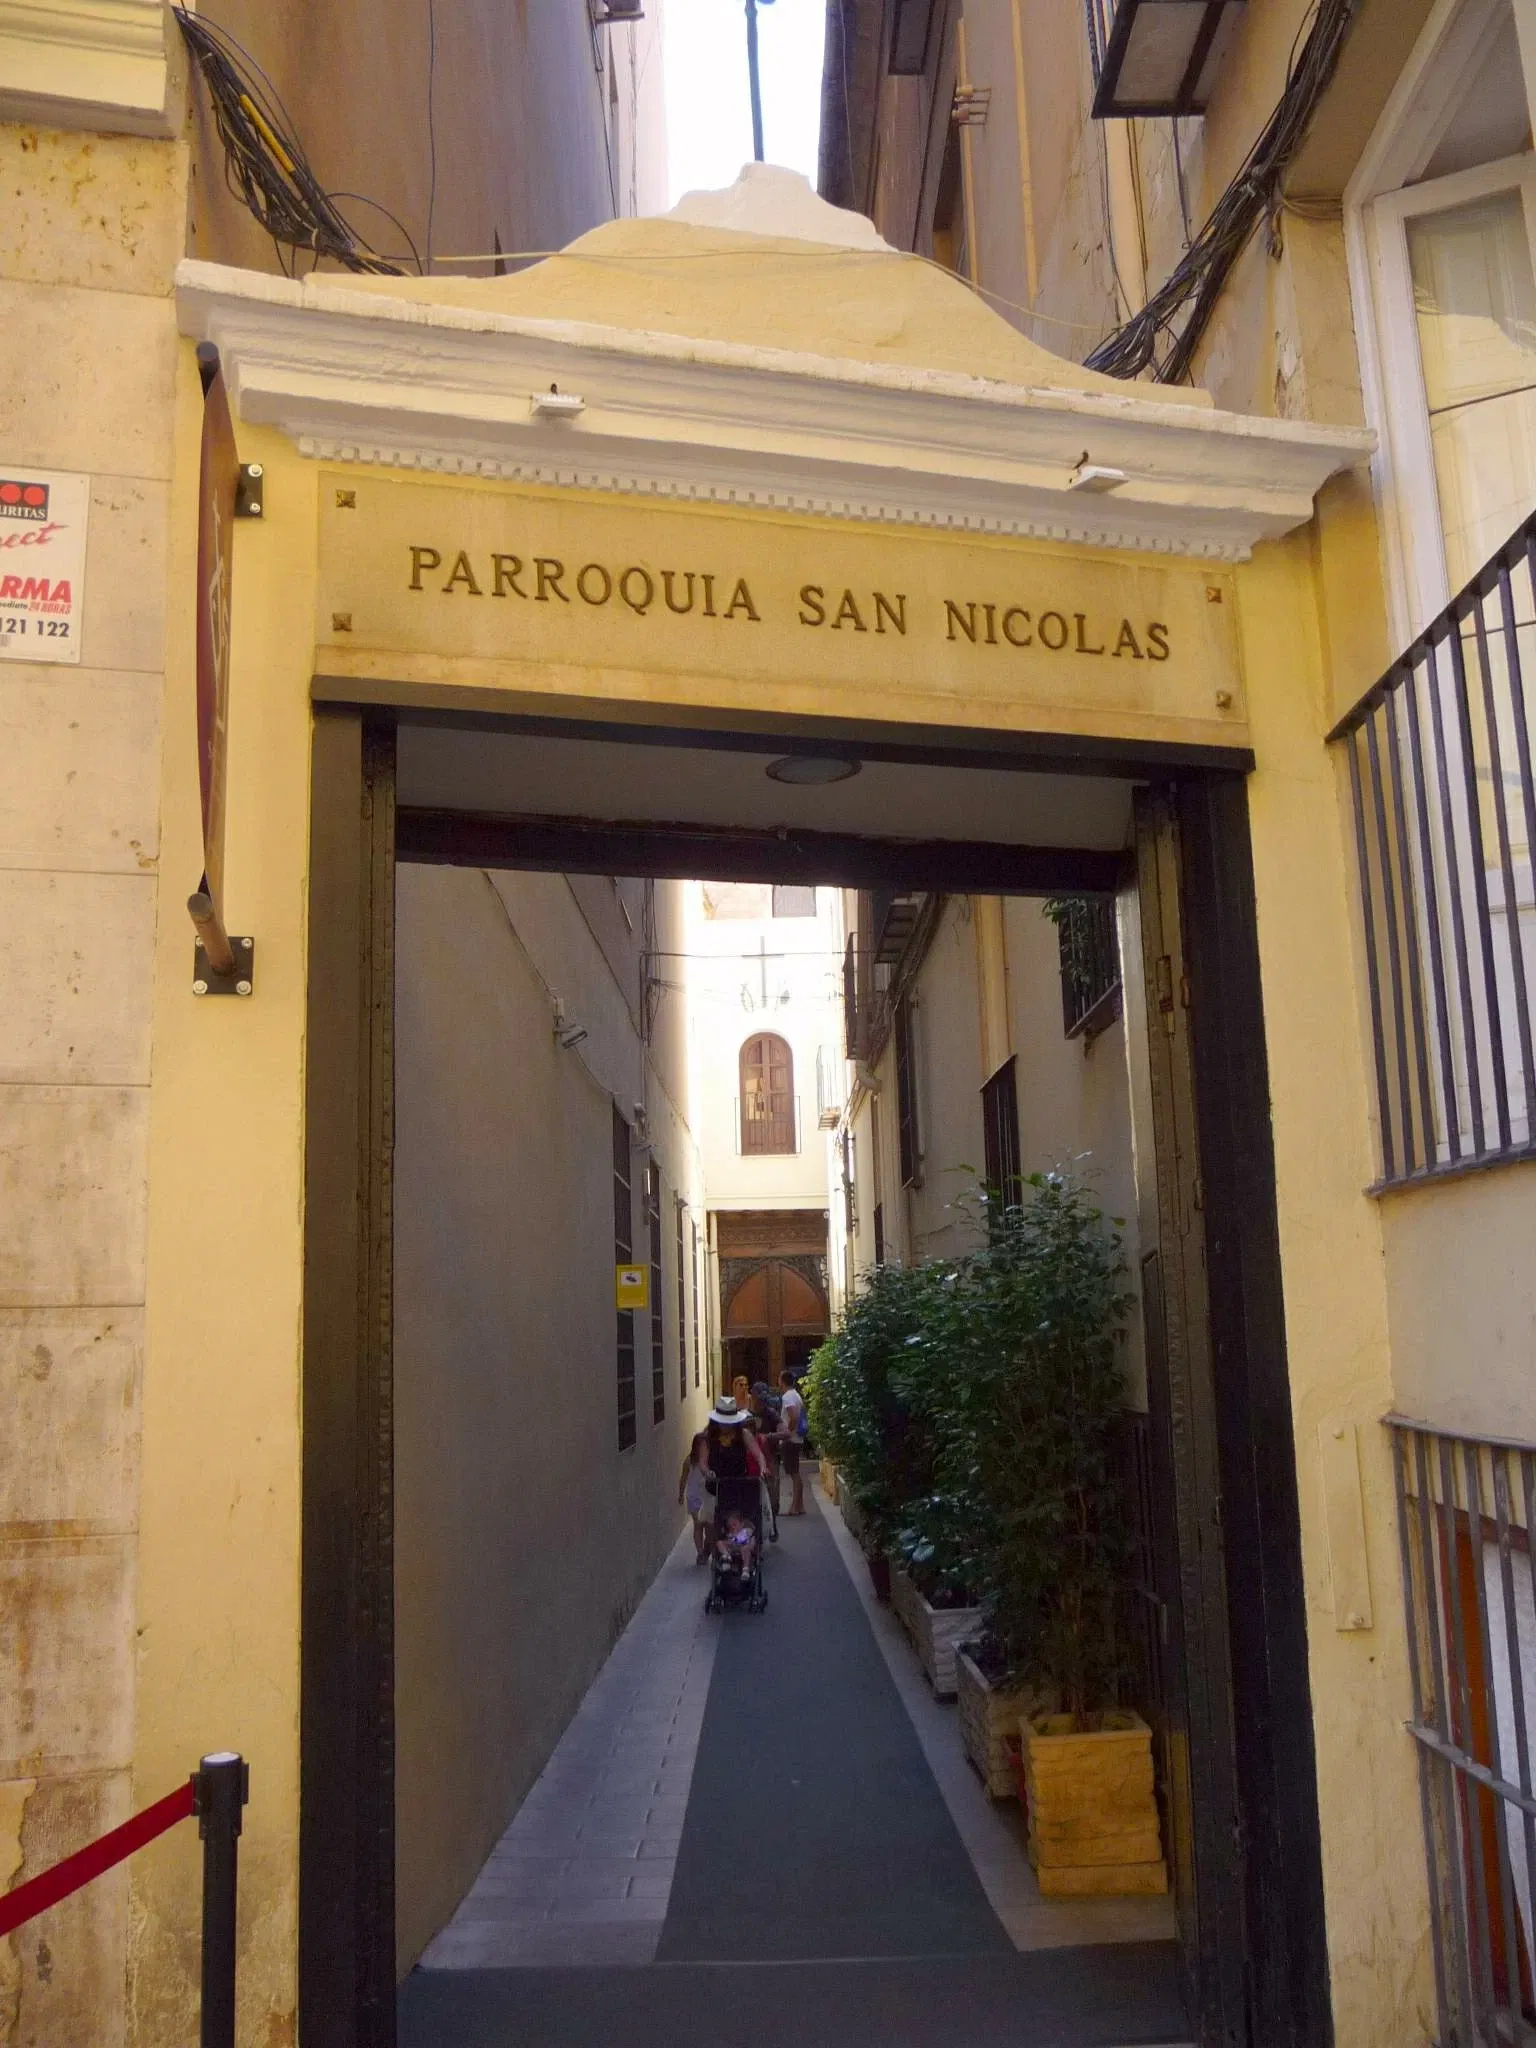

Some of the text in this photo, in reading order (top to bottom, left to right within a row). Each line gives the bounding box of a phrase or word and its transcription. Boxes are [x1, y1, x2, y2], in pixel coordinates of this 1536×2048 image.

[0, 521, 69, 548] ect
[0, 575, 71, 603] RMA
[408, 545, 1171, 661] PARROQUIA SAN NICOLAS
[37, 620, 69, 637] 122
